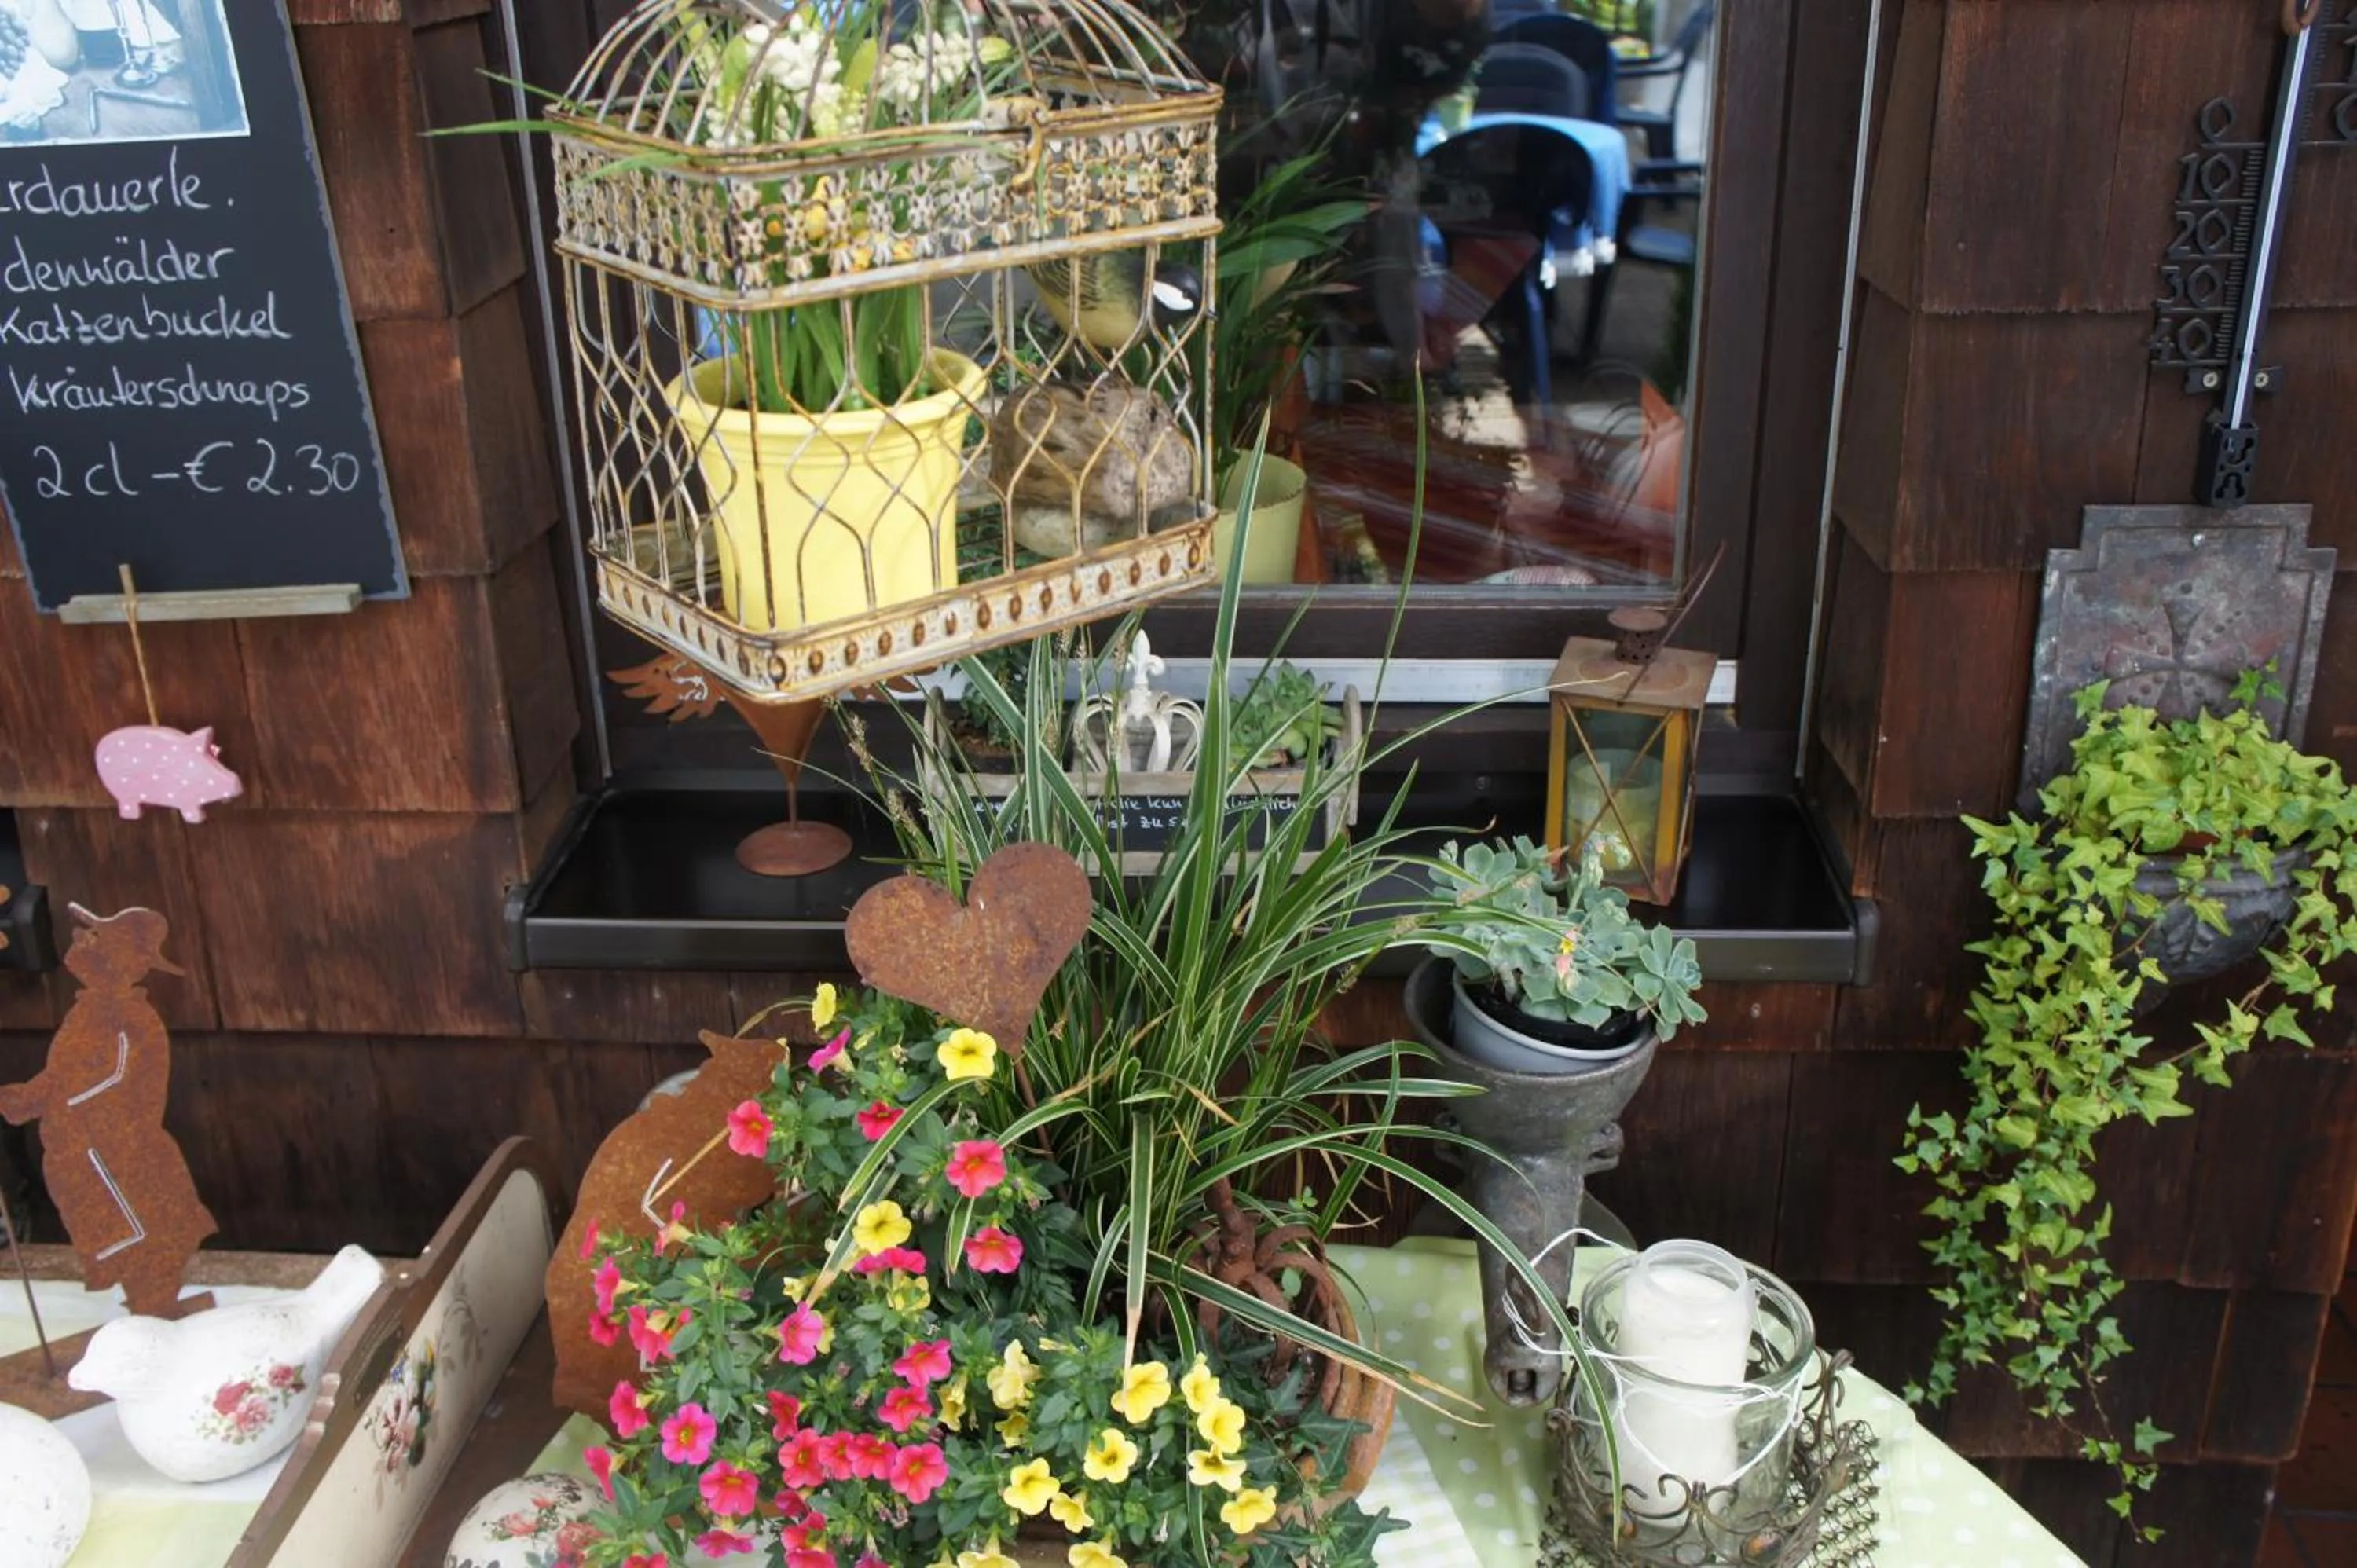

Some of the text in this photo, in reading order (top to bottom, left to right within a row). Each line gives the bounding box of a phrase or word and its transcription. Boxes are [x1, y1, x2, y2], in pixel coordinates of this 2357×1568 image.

[0, 145, 234, 218] rdauerle.
[2179, 152, 2237, 203] 10
[2167, 208, 2231, 258] 20
[2156, 264, 2223, 310] 30
[2149, 317, 2213, 362] 40
[33, 445, 72, 499] 2
[85, 440, 139, 496] cl
[246, 438, 360, 496] 2.30
